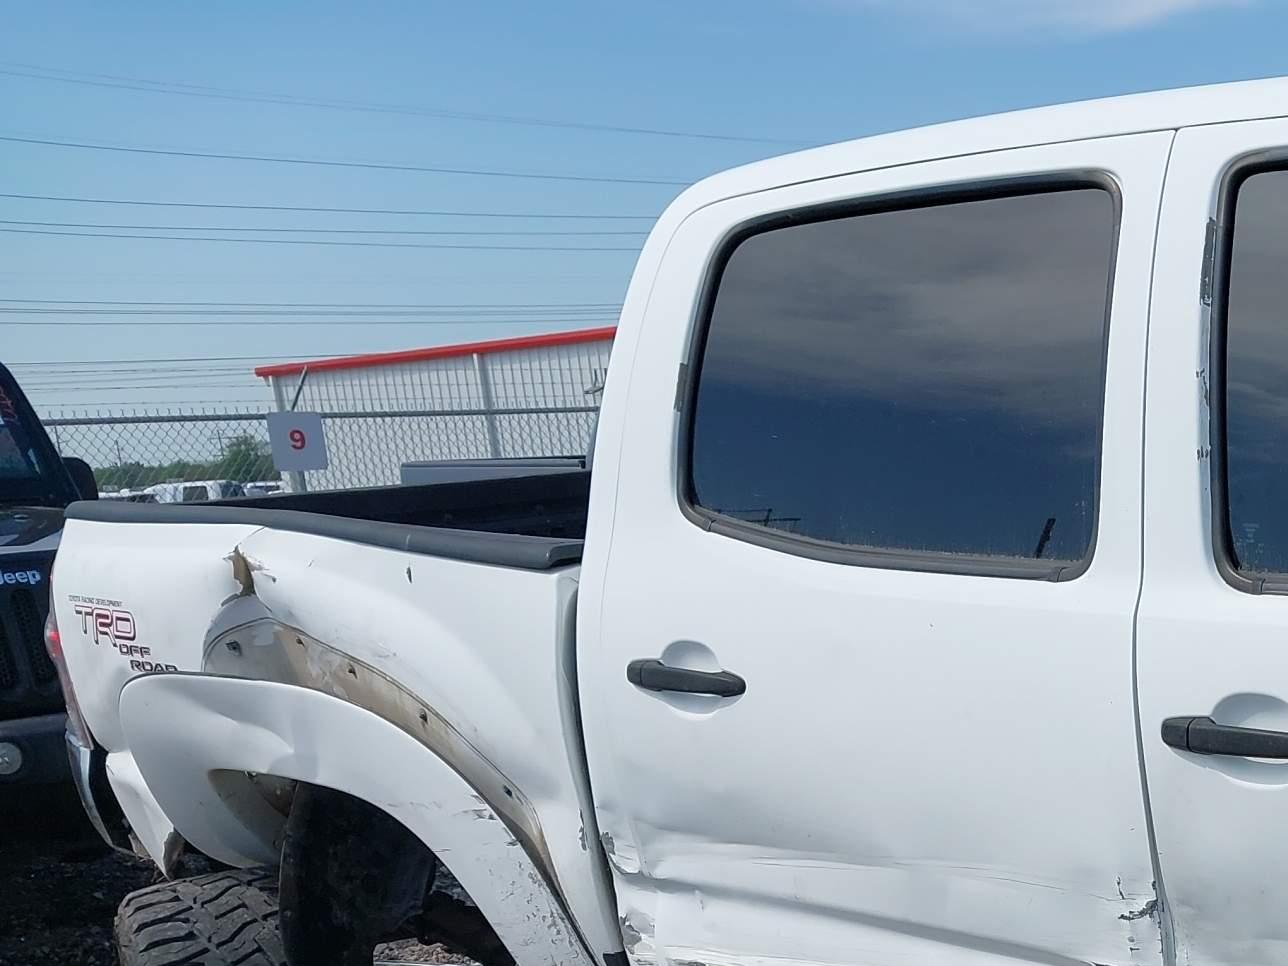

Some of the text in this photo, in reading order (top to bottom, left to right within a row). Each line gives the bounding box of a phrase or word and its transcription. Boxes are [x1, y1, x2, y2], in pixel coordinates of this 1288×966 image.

[289, 430, 306, 450] 9
[75, 605, 136, 648] TRD
[119, 643, 151, 658] OFF
